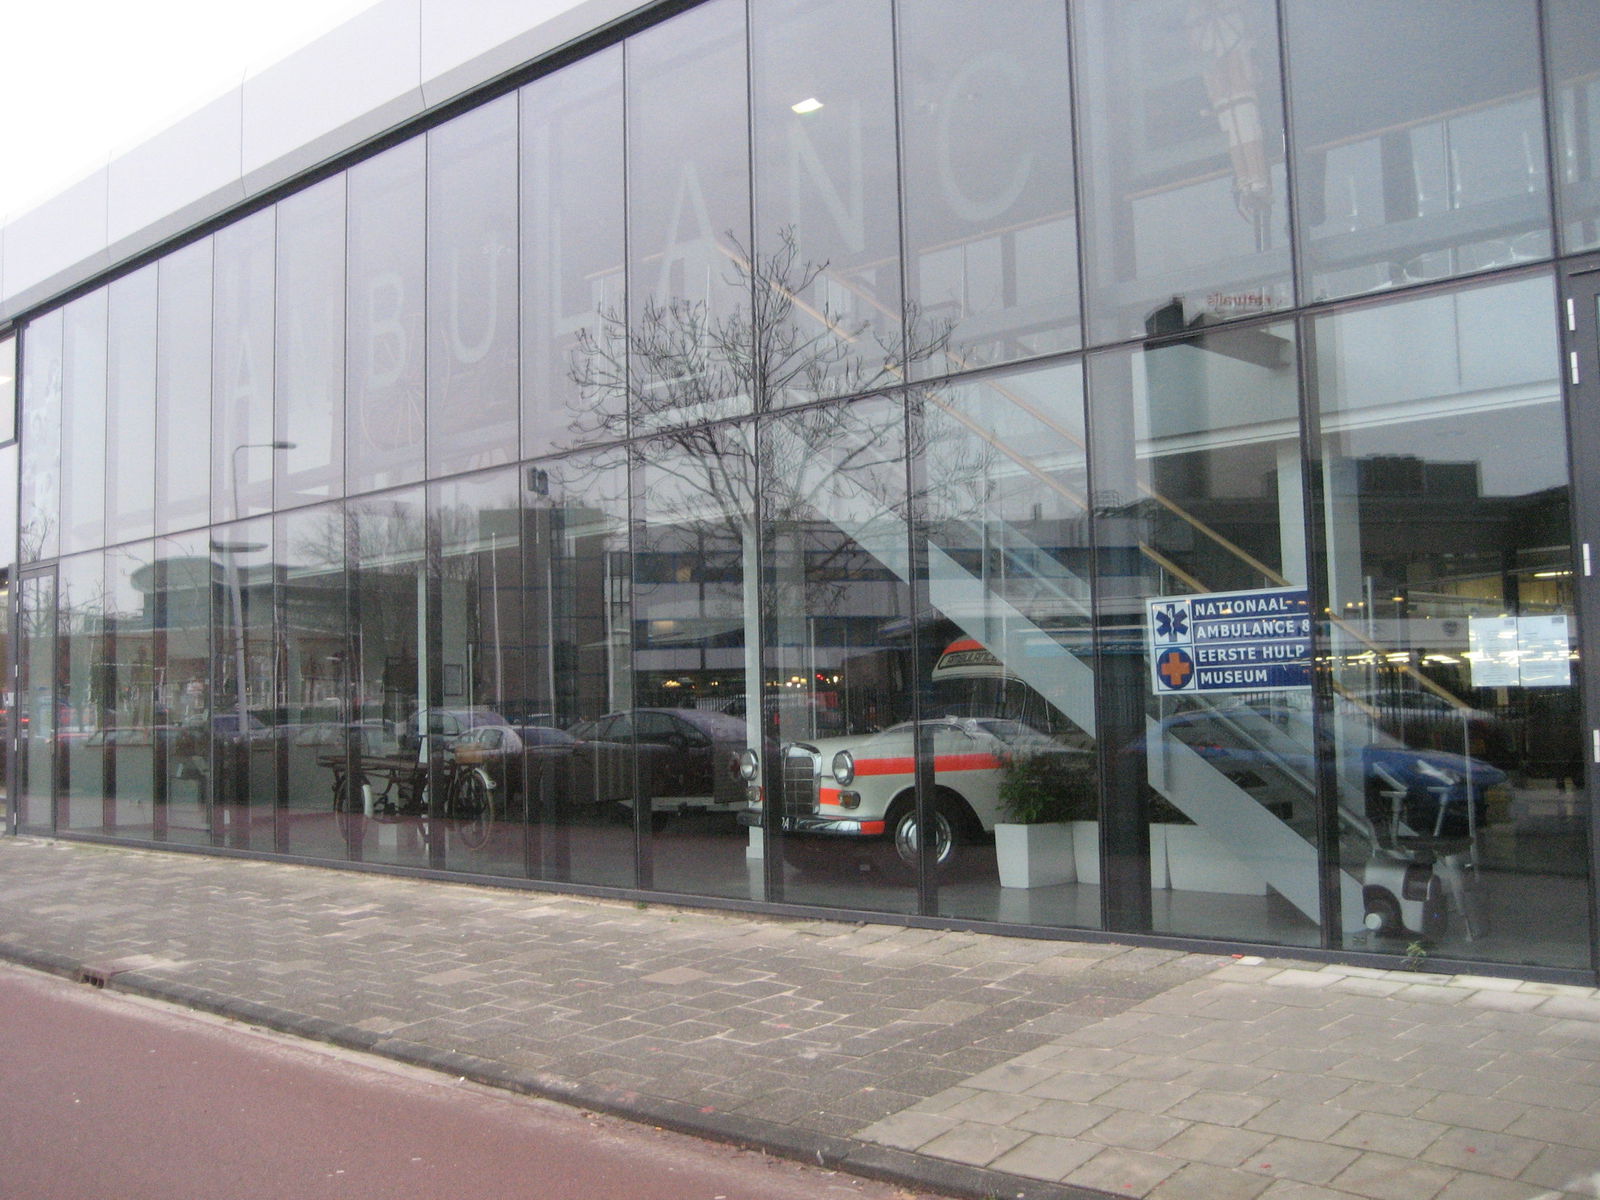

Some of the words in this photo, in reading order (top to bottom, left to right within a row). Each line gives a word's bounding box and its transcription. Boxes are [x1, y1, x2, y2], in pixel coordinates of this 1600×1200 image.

[1195, 597, 1287, 617] NATIONAAL
[1197, 620, 1294, 639] AMBULANCE
[1302, 619, 1310, 632] &
[1199, 647, 1256, 662] EERSTE
[1263, 644, 1304, 659] HULP
[1200, 669, 1268, 685] MUSEUM
